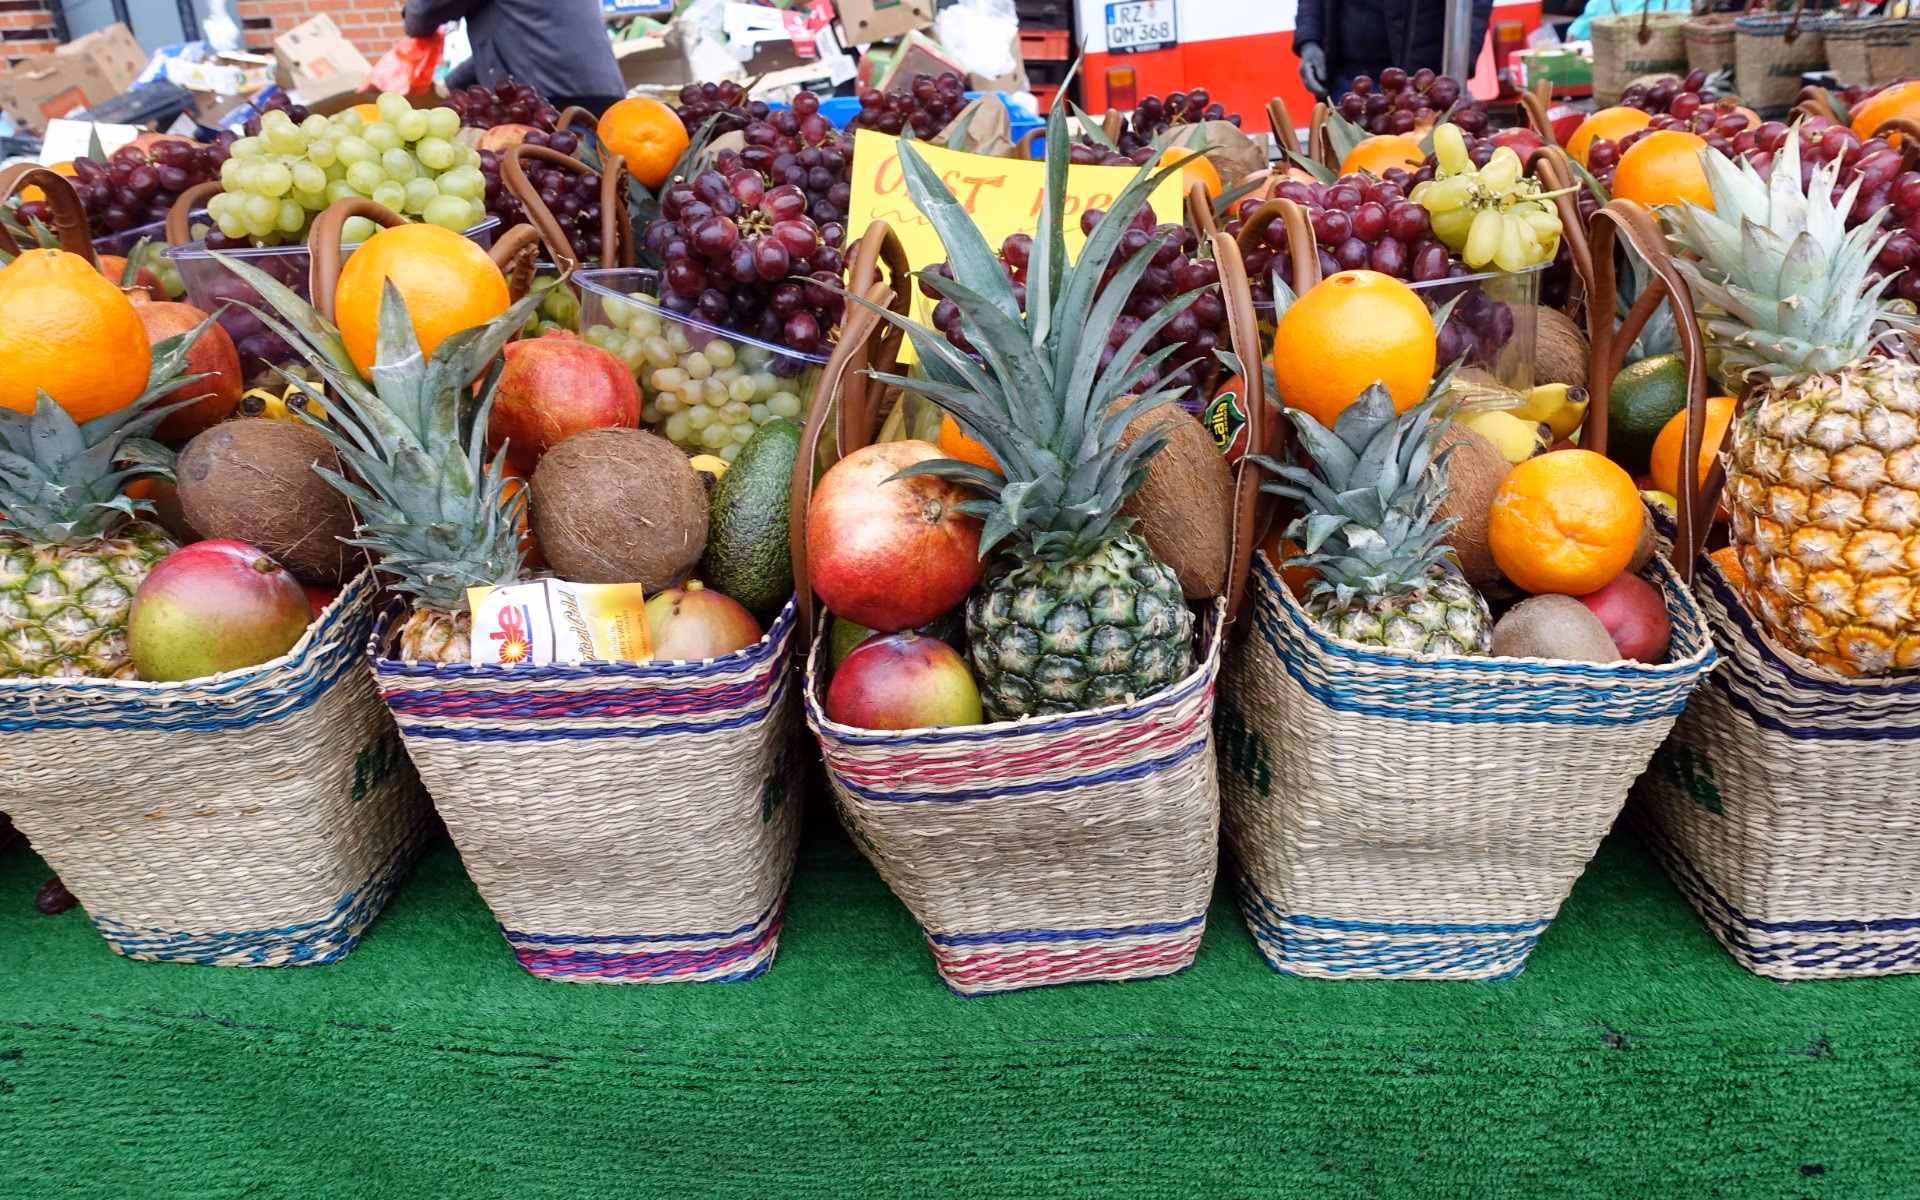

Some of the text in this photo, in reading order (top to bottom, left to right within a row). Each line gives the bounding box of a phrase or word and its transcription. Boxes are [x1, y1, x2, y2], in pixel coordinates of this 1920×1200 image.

[1121, 6, 1142, 23] RZ
[1139, 22, 1169, 40] 368
[874, 153, 1007, 214] OST
[490, 604, 531, 663] ole
[558, 590, 597, 662] pical Gold
[615, 615, 625, 639] SWEET
